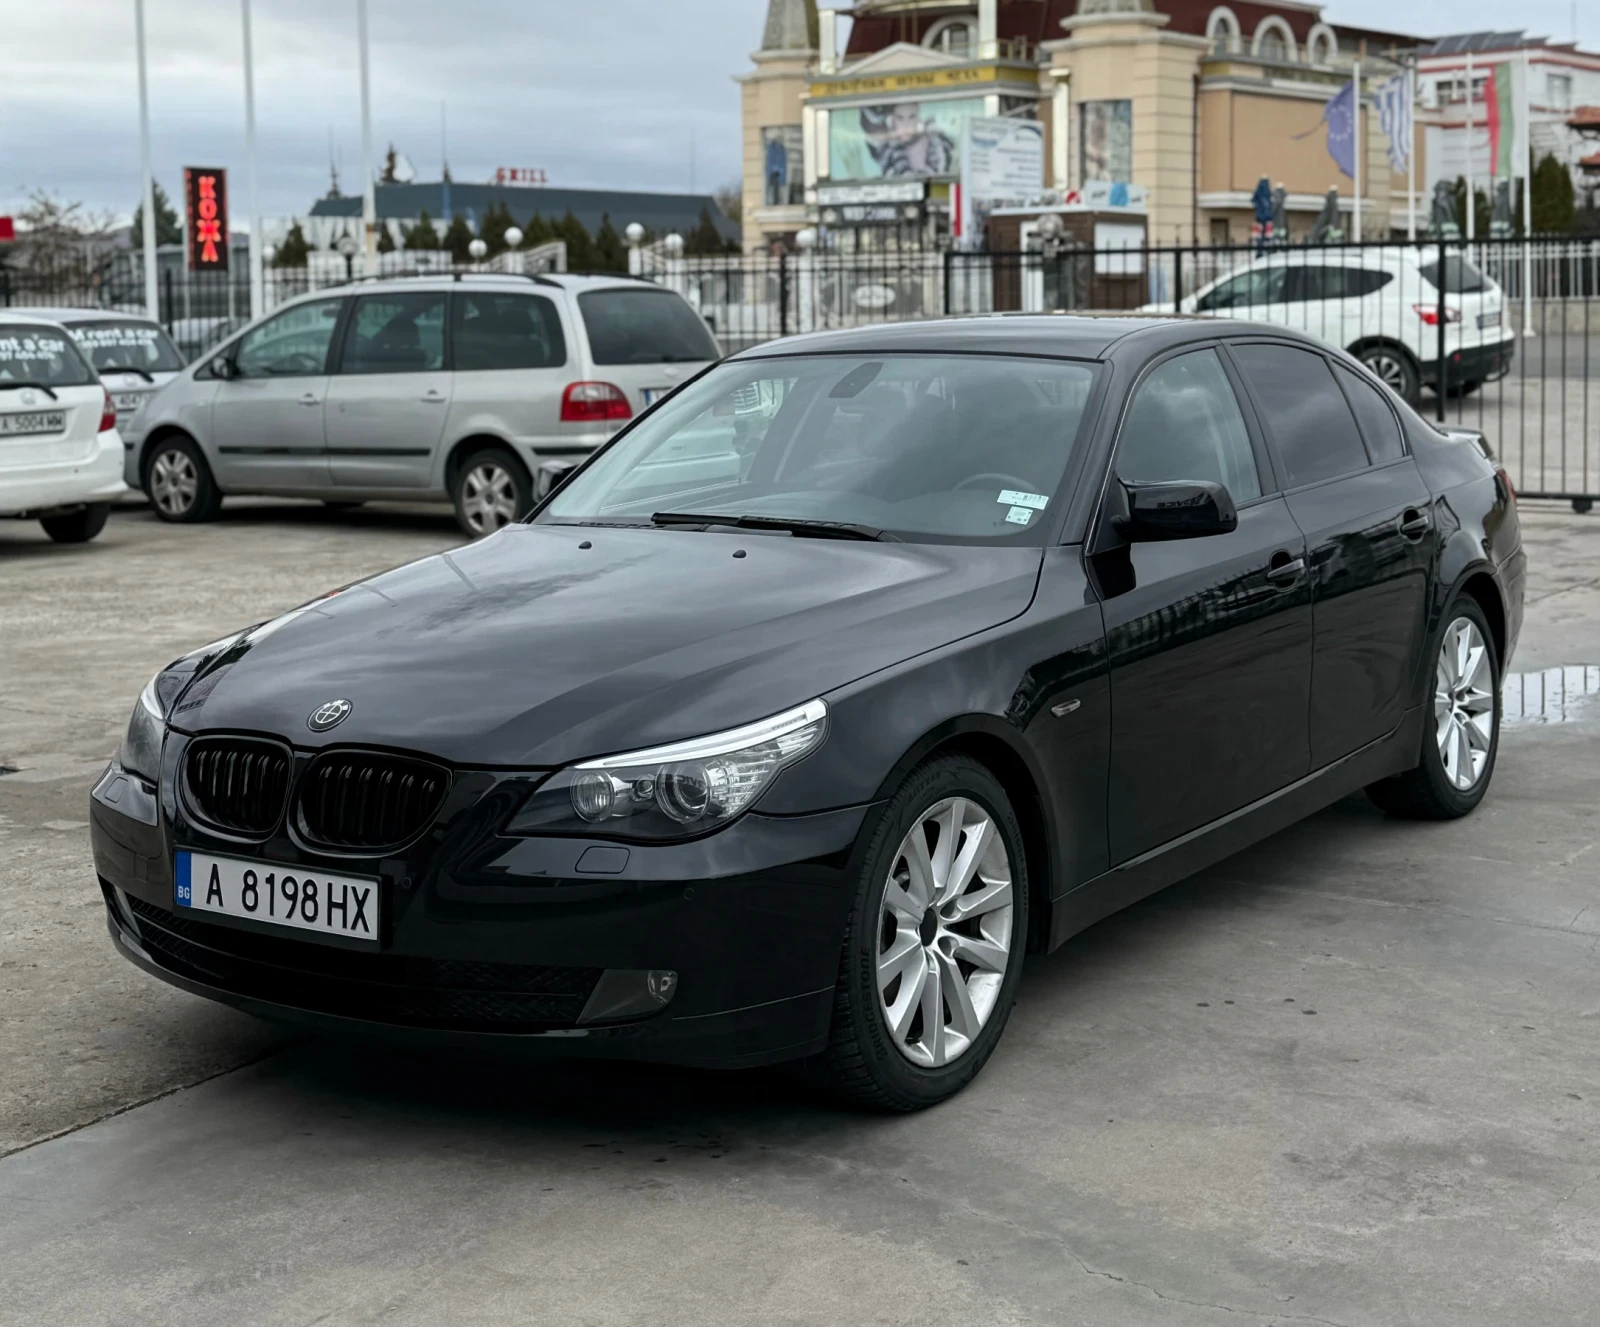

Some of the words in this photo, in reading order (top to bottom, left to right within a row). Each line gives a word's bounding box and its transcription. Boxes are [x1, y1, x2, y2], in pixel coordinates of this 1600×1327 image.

[495, 167, 547, 182] GRILL
[178, 885, 190, 899] BG
[206, 863, 224, 907] A
[859, 945, 888, 1063] BRIDGESTONE
